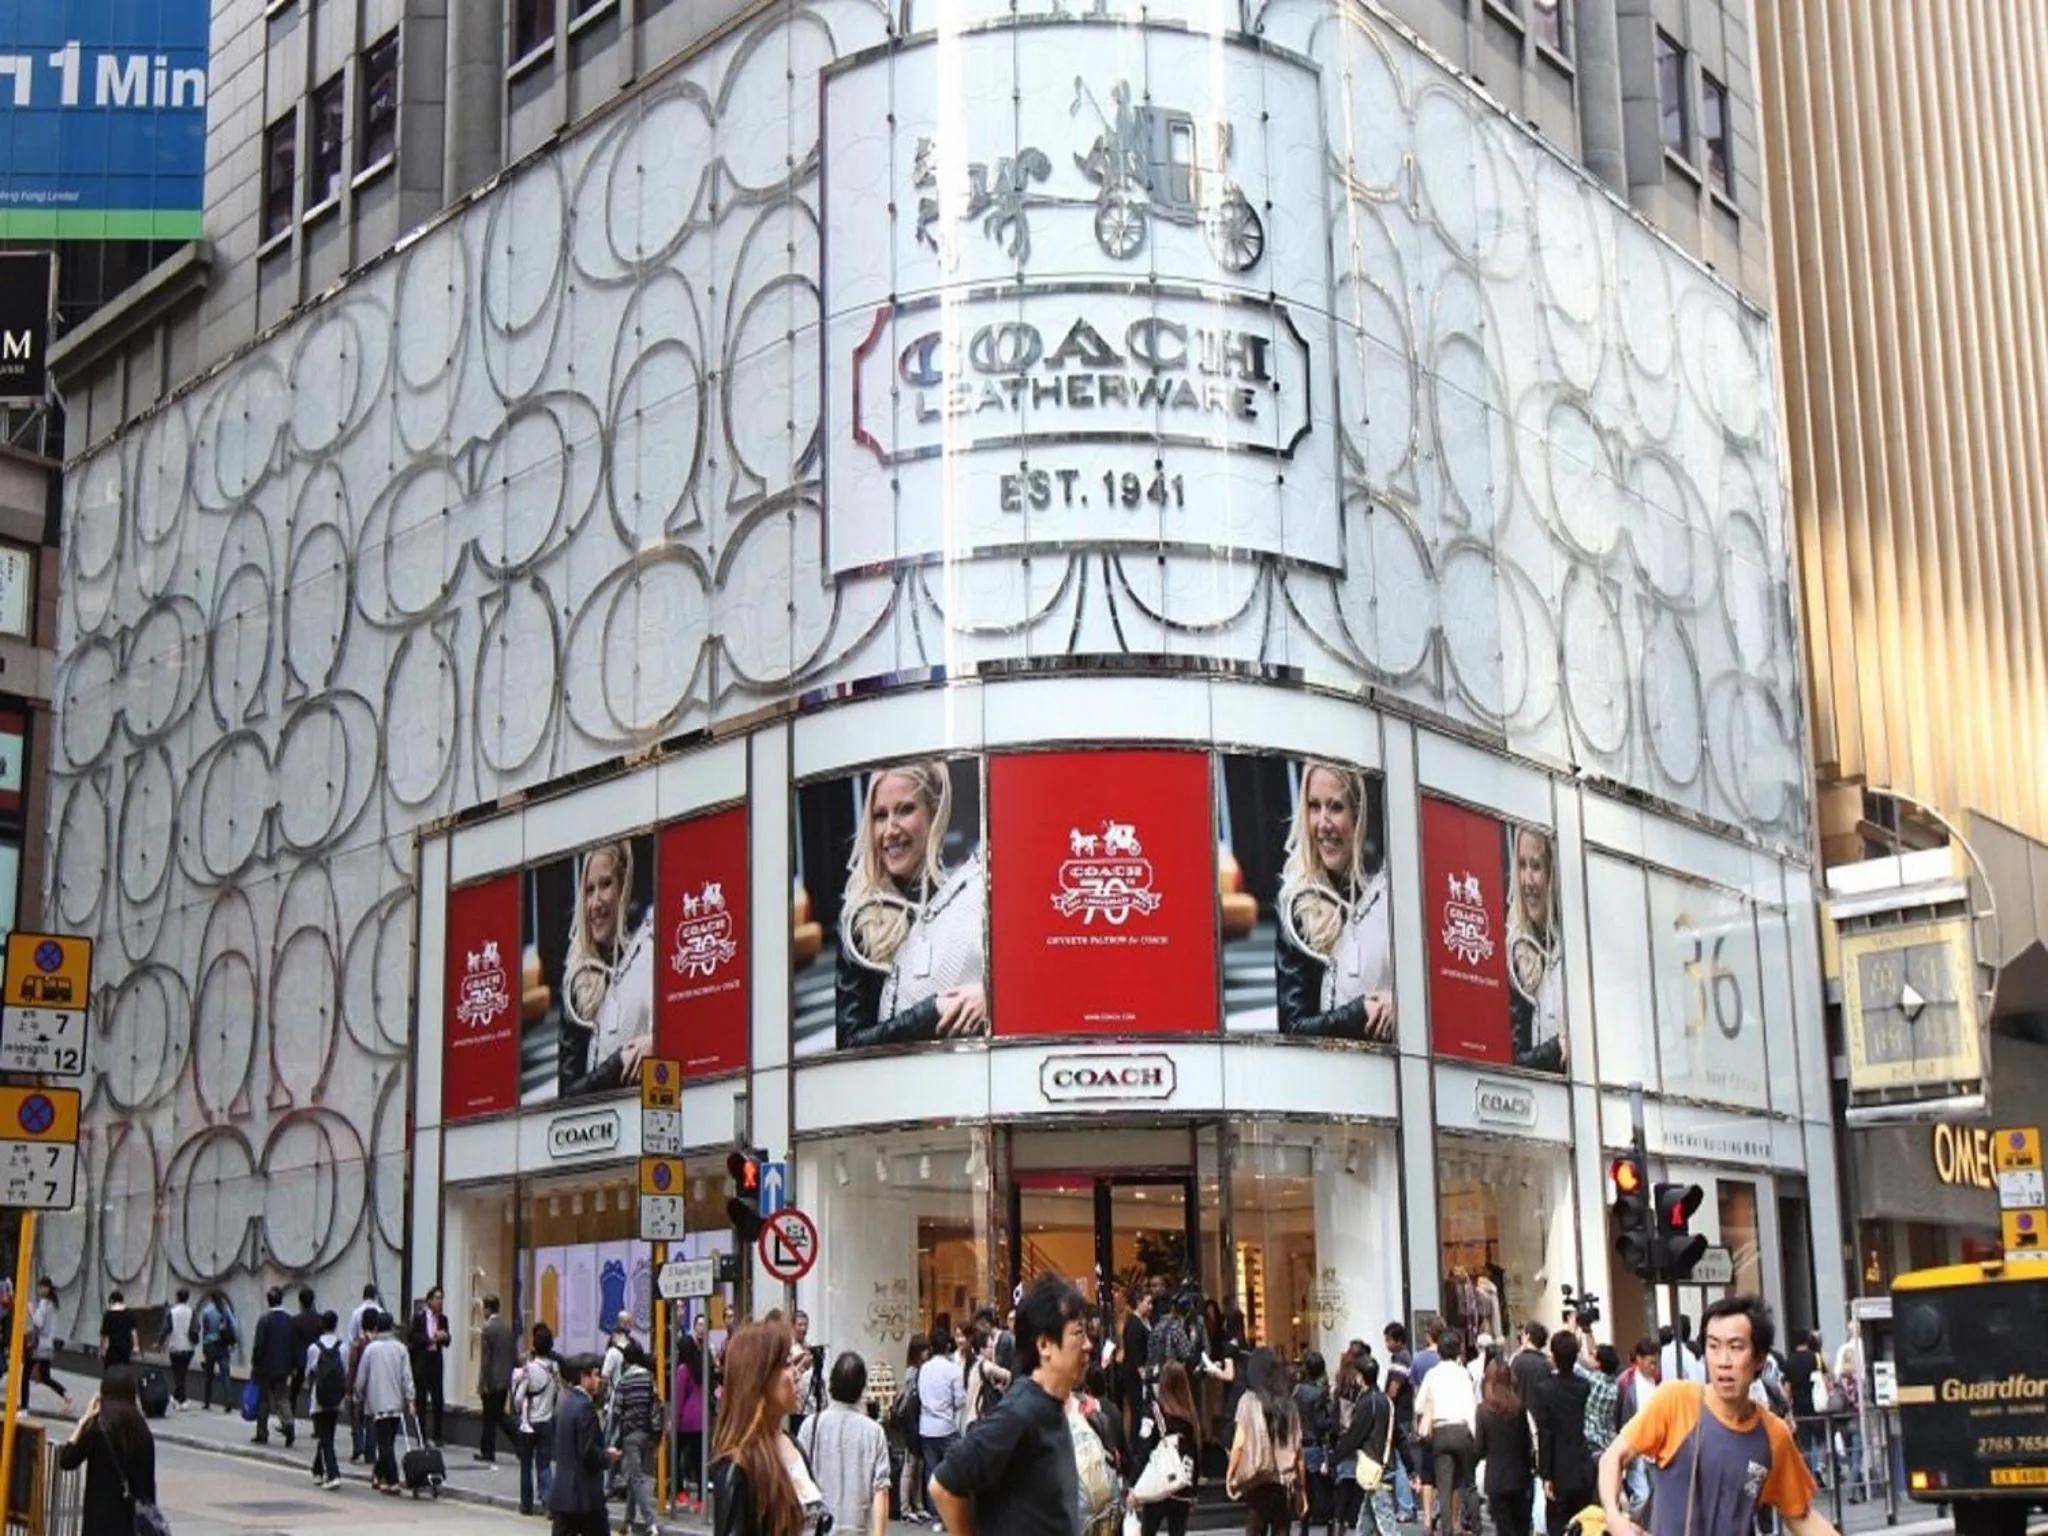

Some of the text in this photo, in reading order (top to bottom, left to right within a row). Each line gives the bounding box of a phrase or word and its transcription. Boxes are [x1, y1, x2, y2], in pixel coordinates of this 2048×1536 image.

[48, 40, 81, 106] 1
[95, 55, 206, 107] Min
[899, 315, 1271, 386] COACH
[915, 373, 1258, 424] LEATHERWARE
[1001, 469, 1185, 513] EST. 1941
[1070, 865, 1142, 877] COACH
[55, 1013, 70, 1035] 7
[54, 1048, 78, 1070] 12
[1053, 1067, 1163, 1088] COACH
[555, 1122, 613, 1146] COACH
[46, 1146, 60, 1168] 7
[1935, 1123, 1998, 1190] OME
[44, 1181, 58, 1203] 7
